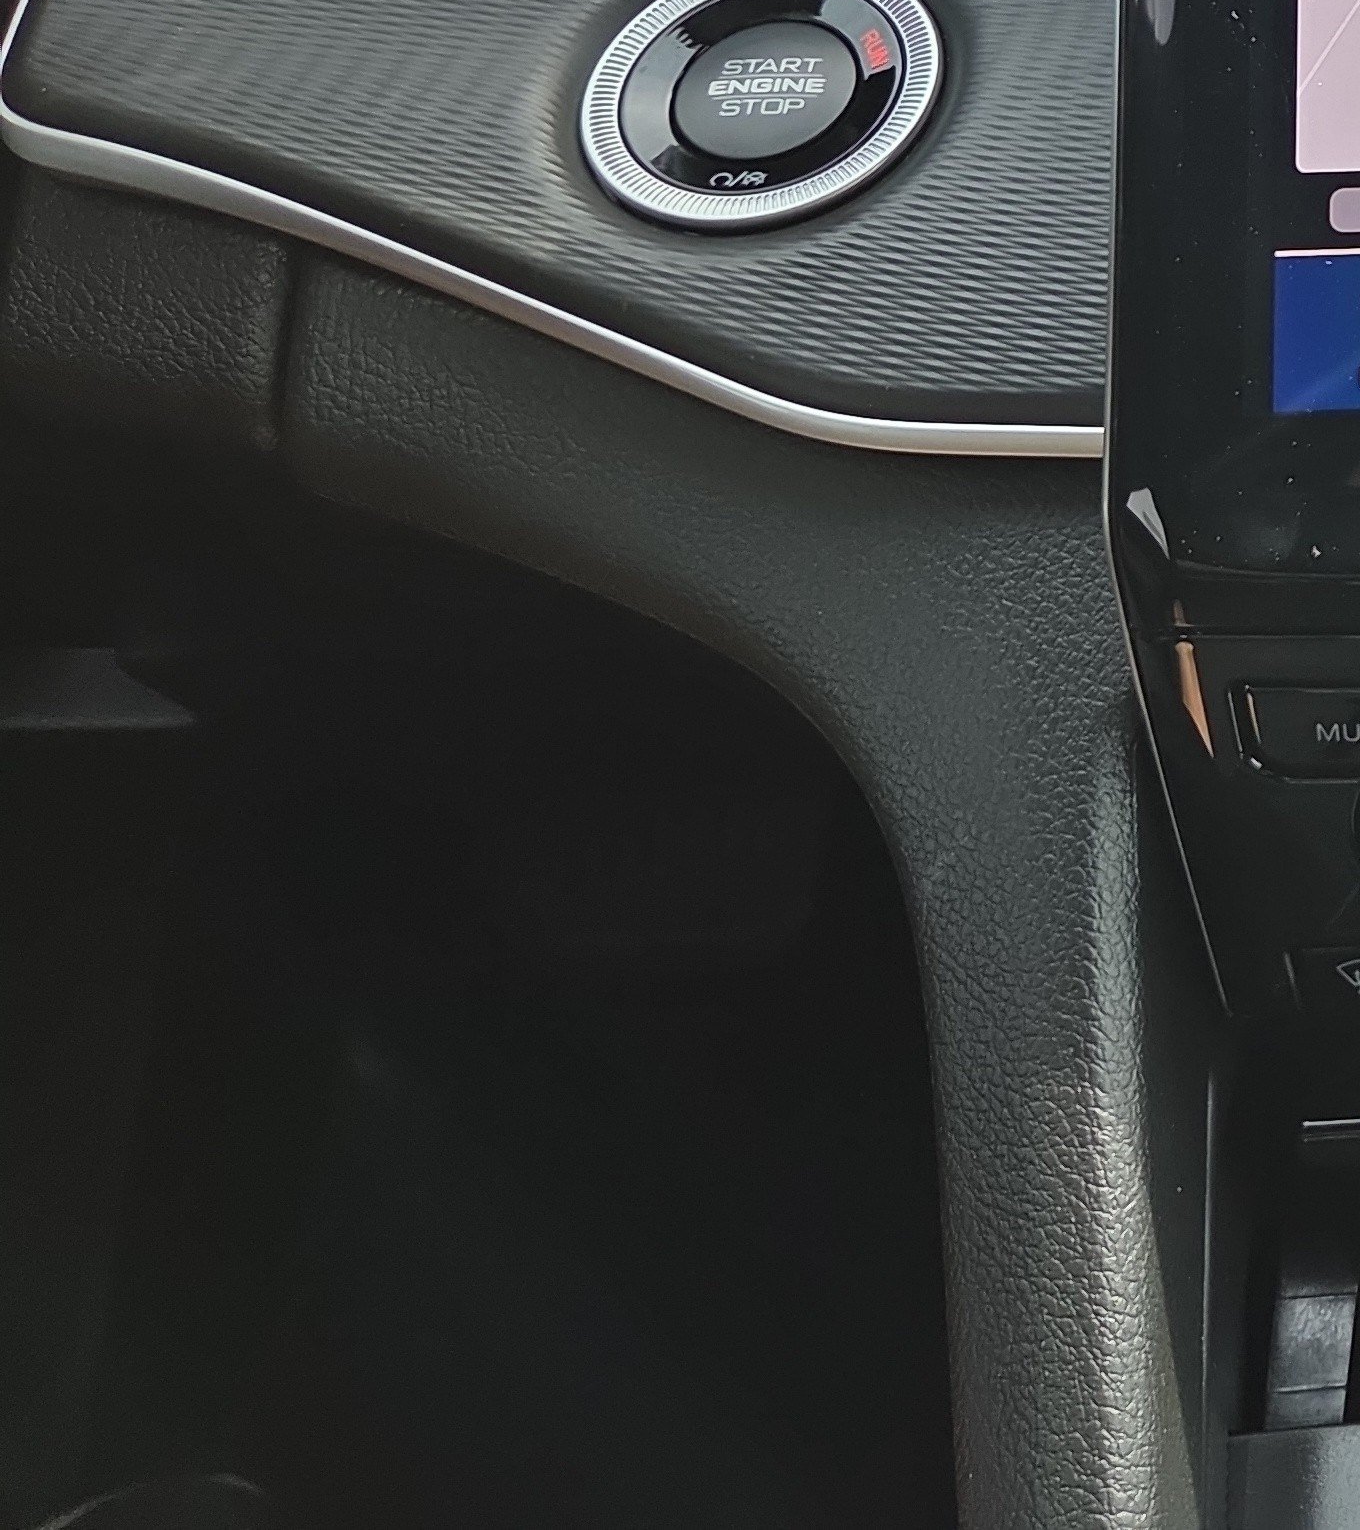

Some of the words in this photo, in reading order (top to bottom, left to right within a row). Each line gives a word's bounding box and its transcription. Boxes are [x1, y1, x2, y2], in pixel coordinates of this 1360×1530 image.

[720, 57, 823, 74] START
[707, 77, 828, 96] ENGINE
[717, 97, 807, 117] STOP
